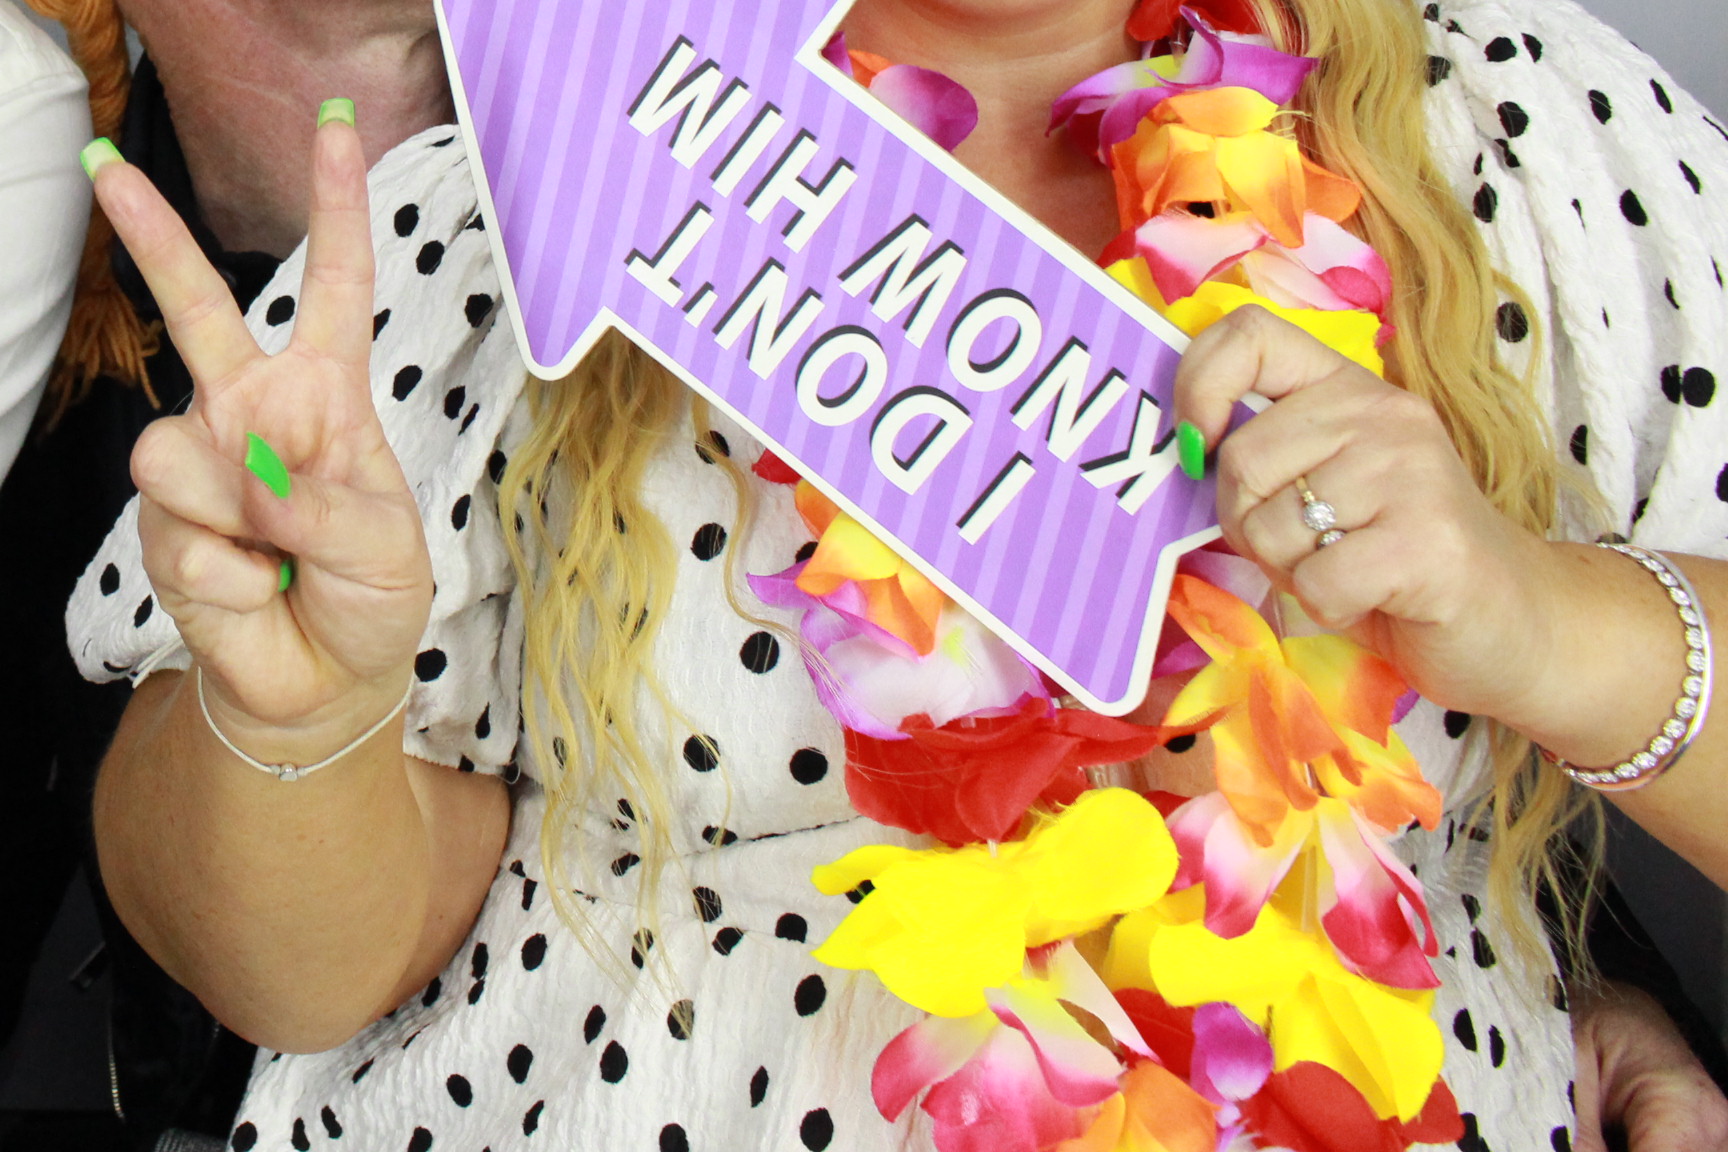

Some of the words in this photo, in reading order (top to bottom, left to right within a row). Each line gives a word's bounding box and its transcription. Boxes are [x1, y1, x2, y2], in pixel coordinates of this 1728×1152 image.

[626, 34, 858, 254] HIM
[624, 200, 973, 496] DON'T
[838, 213, 1181, 516] KNOW
[957, 450, 1036, 546] I
